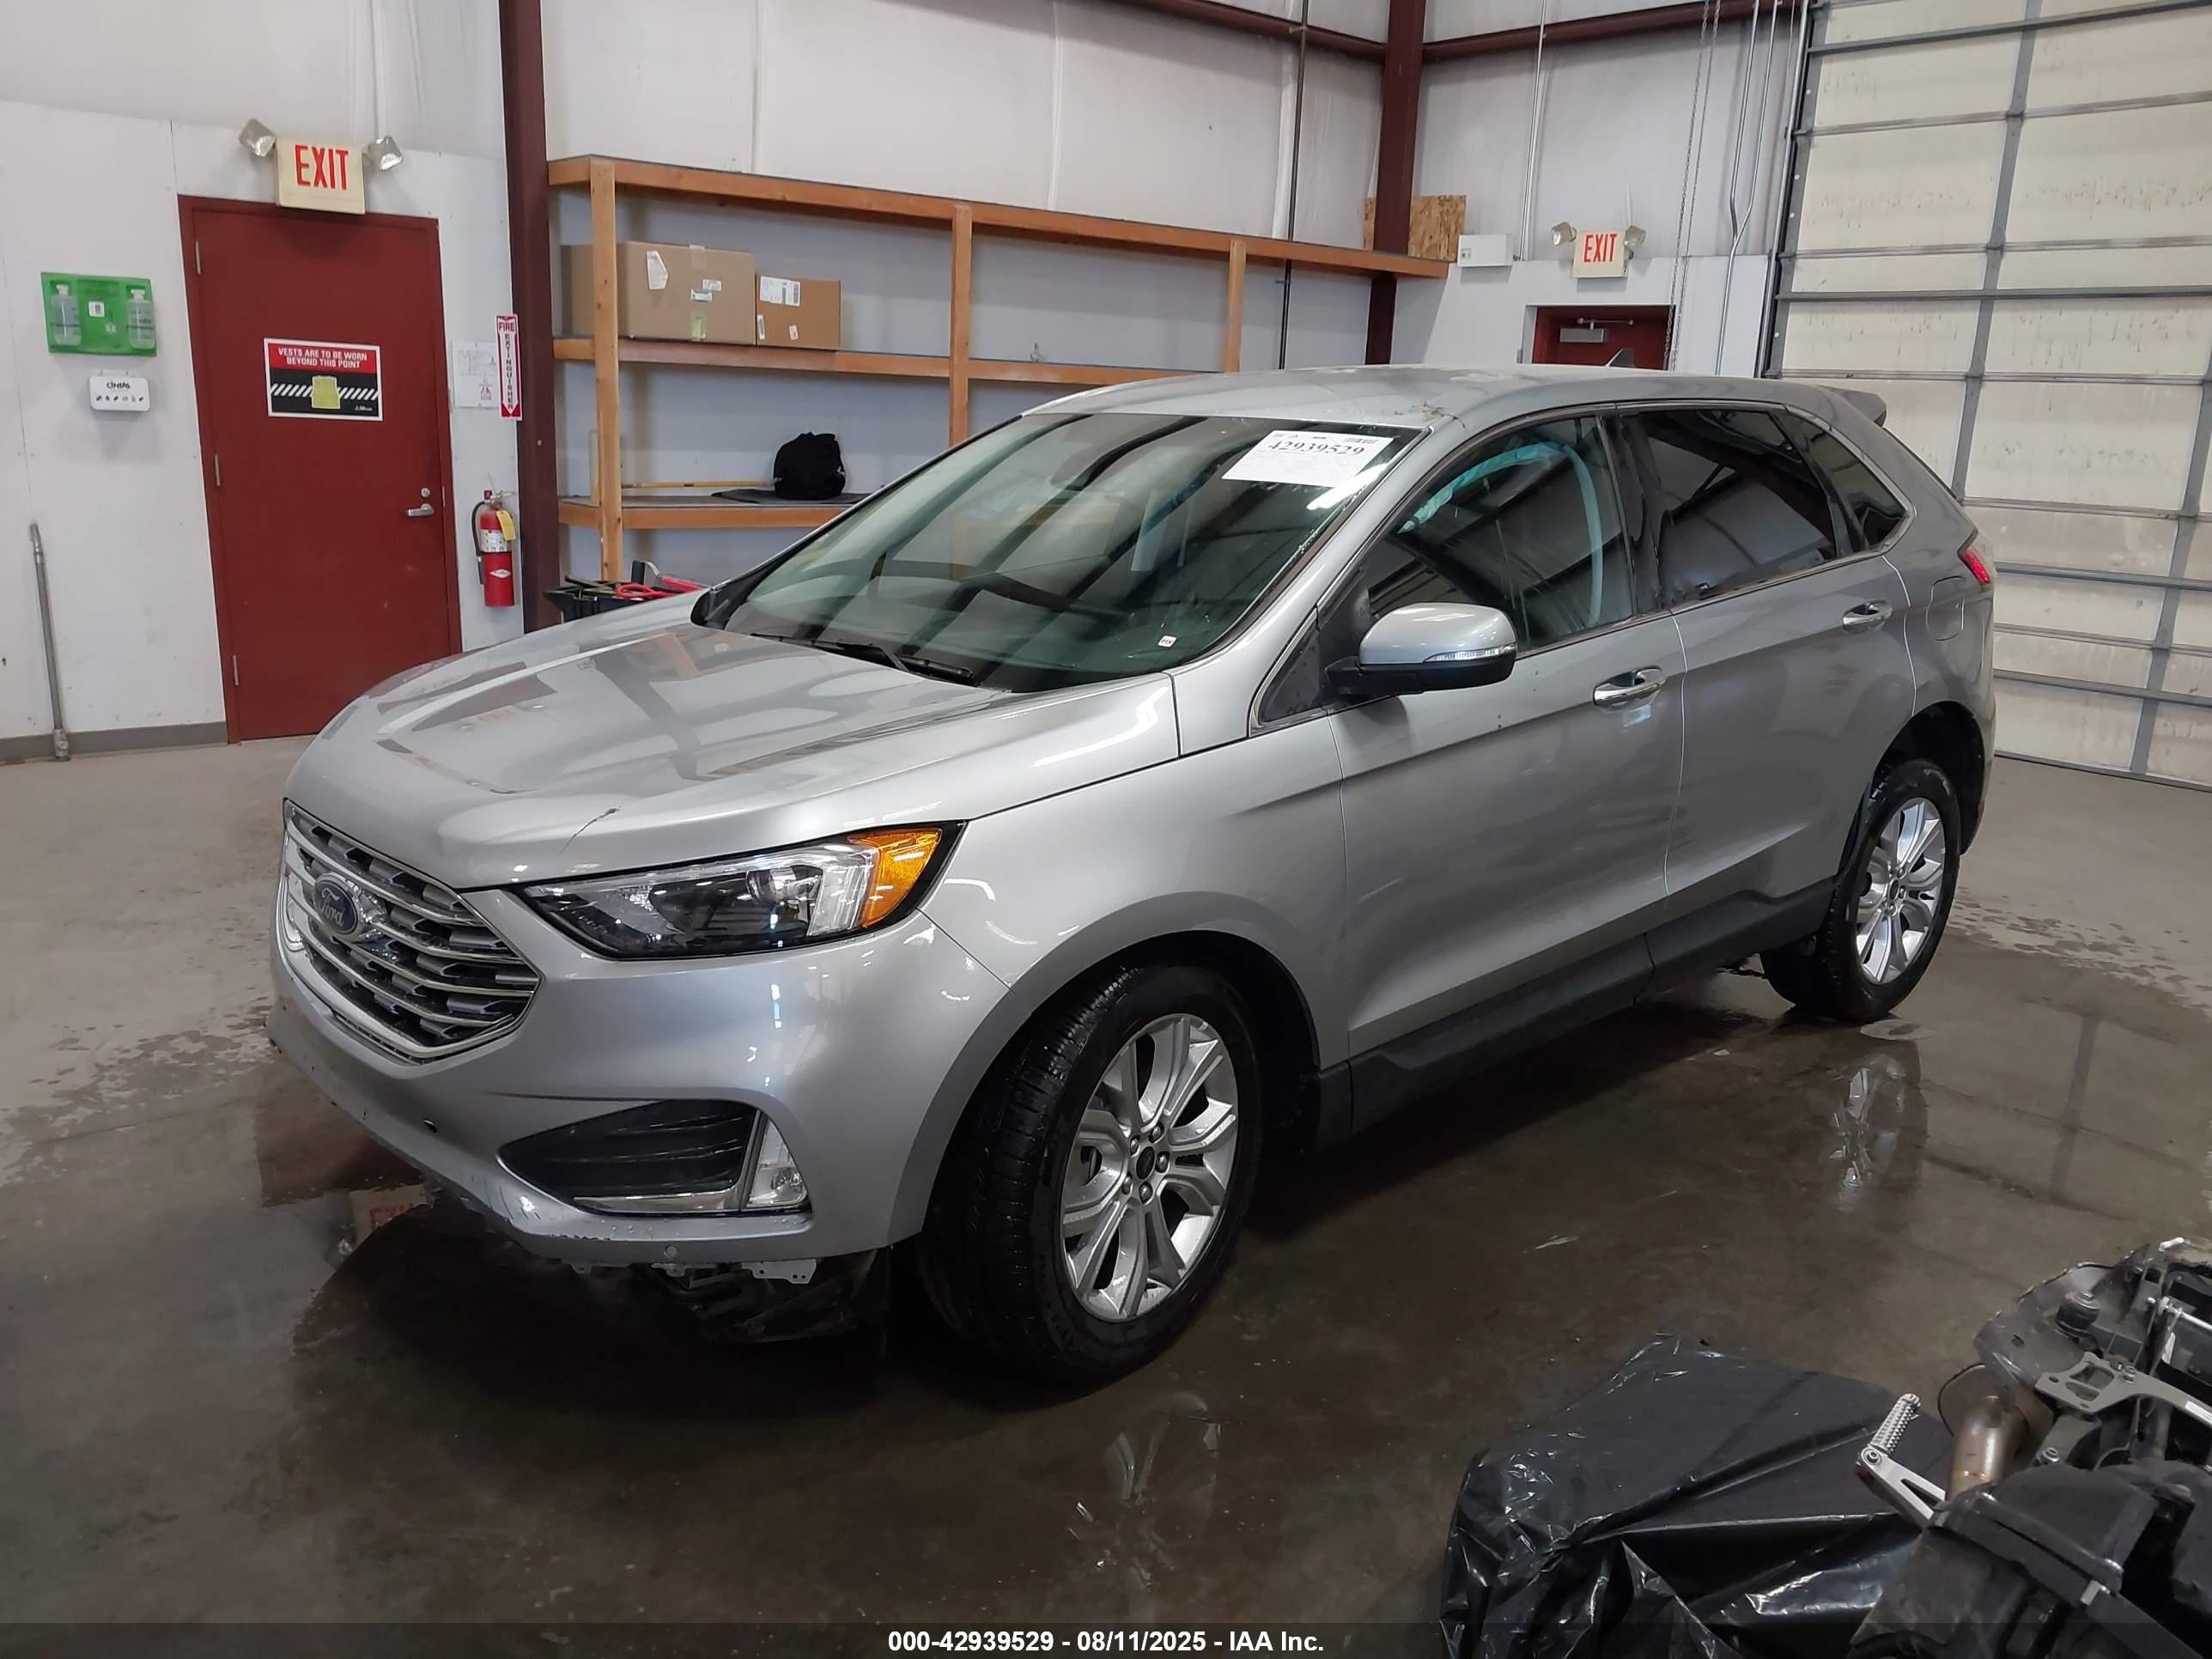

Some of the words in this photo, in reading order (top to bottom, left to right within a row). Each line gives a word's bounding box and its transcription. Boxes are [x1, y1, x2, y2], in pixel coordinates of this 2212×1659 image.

[295, 144, 349, 191] EXIT
[1583, 234, 1618, 263] EXIT
[498, 322, 515, 332] FIRE
[278, 347, 303, 357] VESTS
[304, 349, 319, 358] ARE
[321, 350, 331, 359] TO
[333, 351, 343, 360] BE
[344, 351, 368, 362] WORN
[286, 356, 318, 367] BEYOND
[319, 359, 337, 368] THIS
[338, 360, 361, 369] POINT
[505, 333, 514, 410] EXTINGUISHER
[1267, 441, 1365, 455] 42939529
[318, 887, 345, 927] Ford
